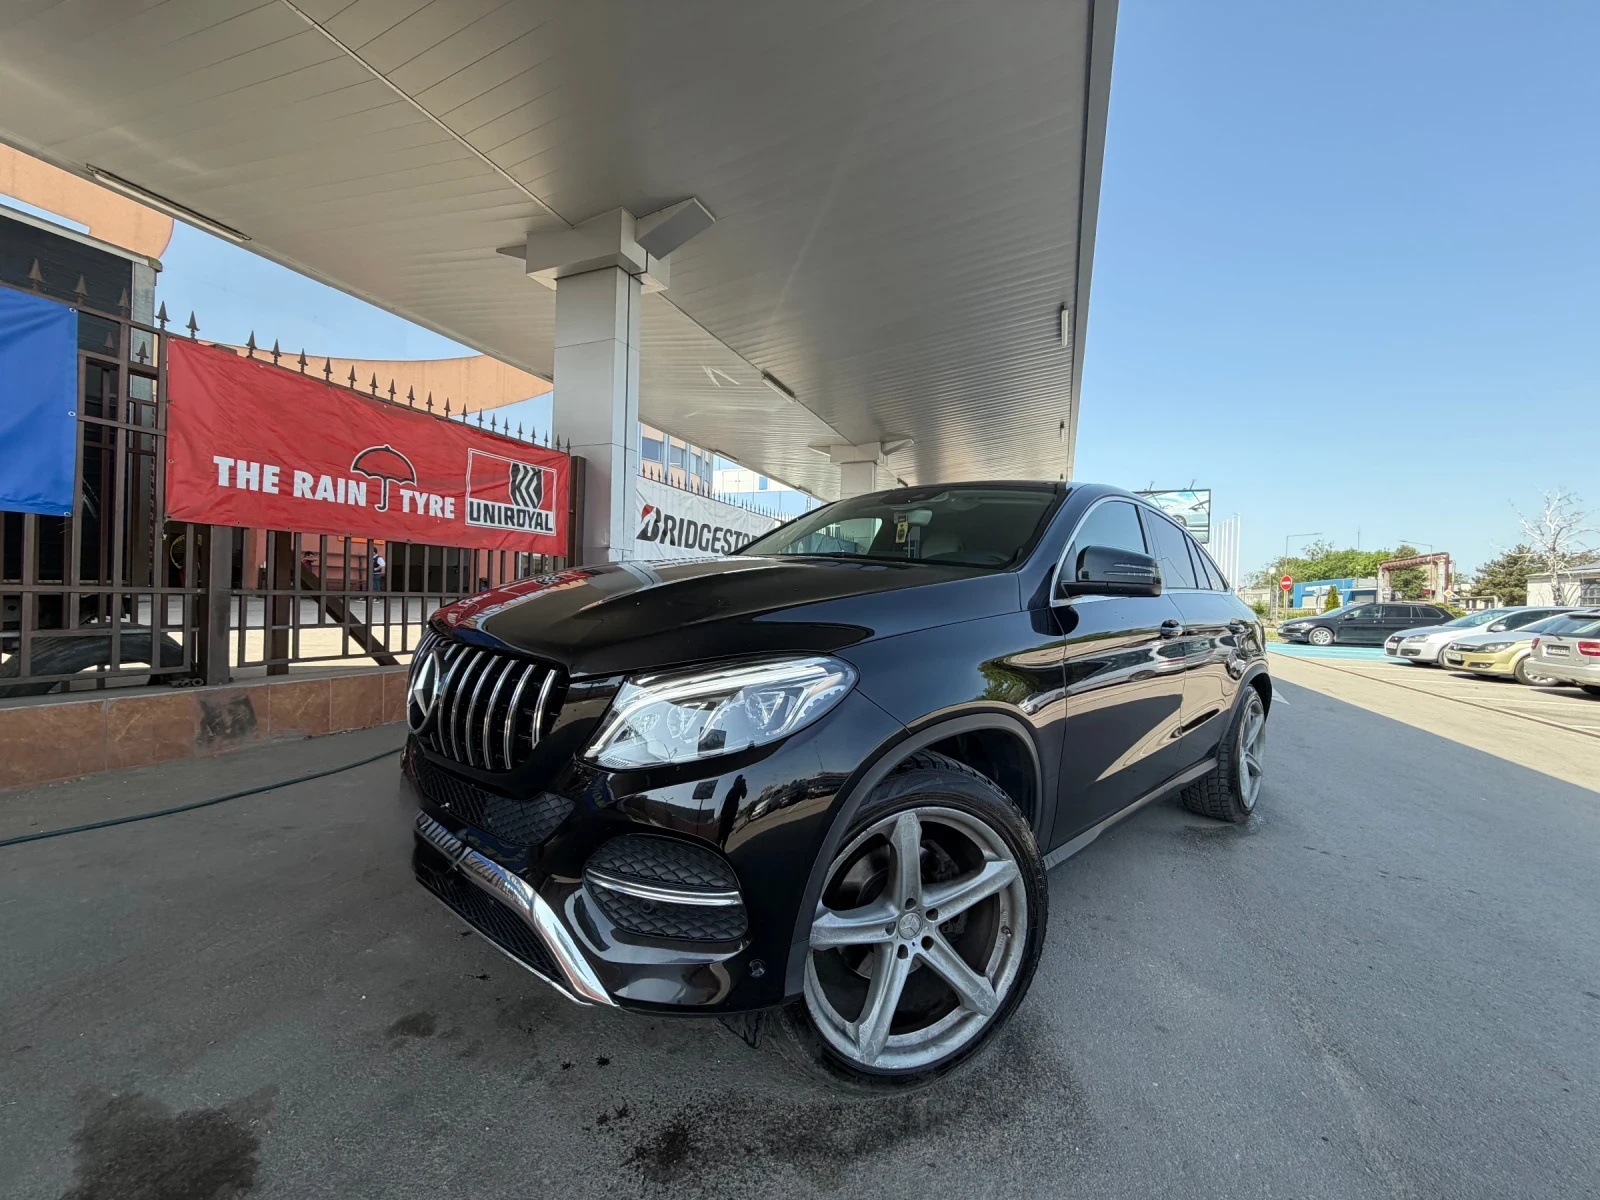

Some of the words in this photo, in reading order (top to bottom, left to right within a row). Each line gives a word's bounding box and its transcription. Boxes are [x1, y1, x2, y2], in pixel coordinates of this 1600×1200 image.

[213, 455, 281, 495] THE
[292, 470, 367, 507] RAIN
[400, 488, 456, 520] TYRE
[468, 500, 555, 532] UNIROYAL
